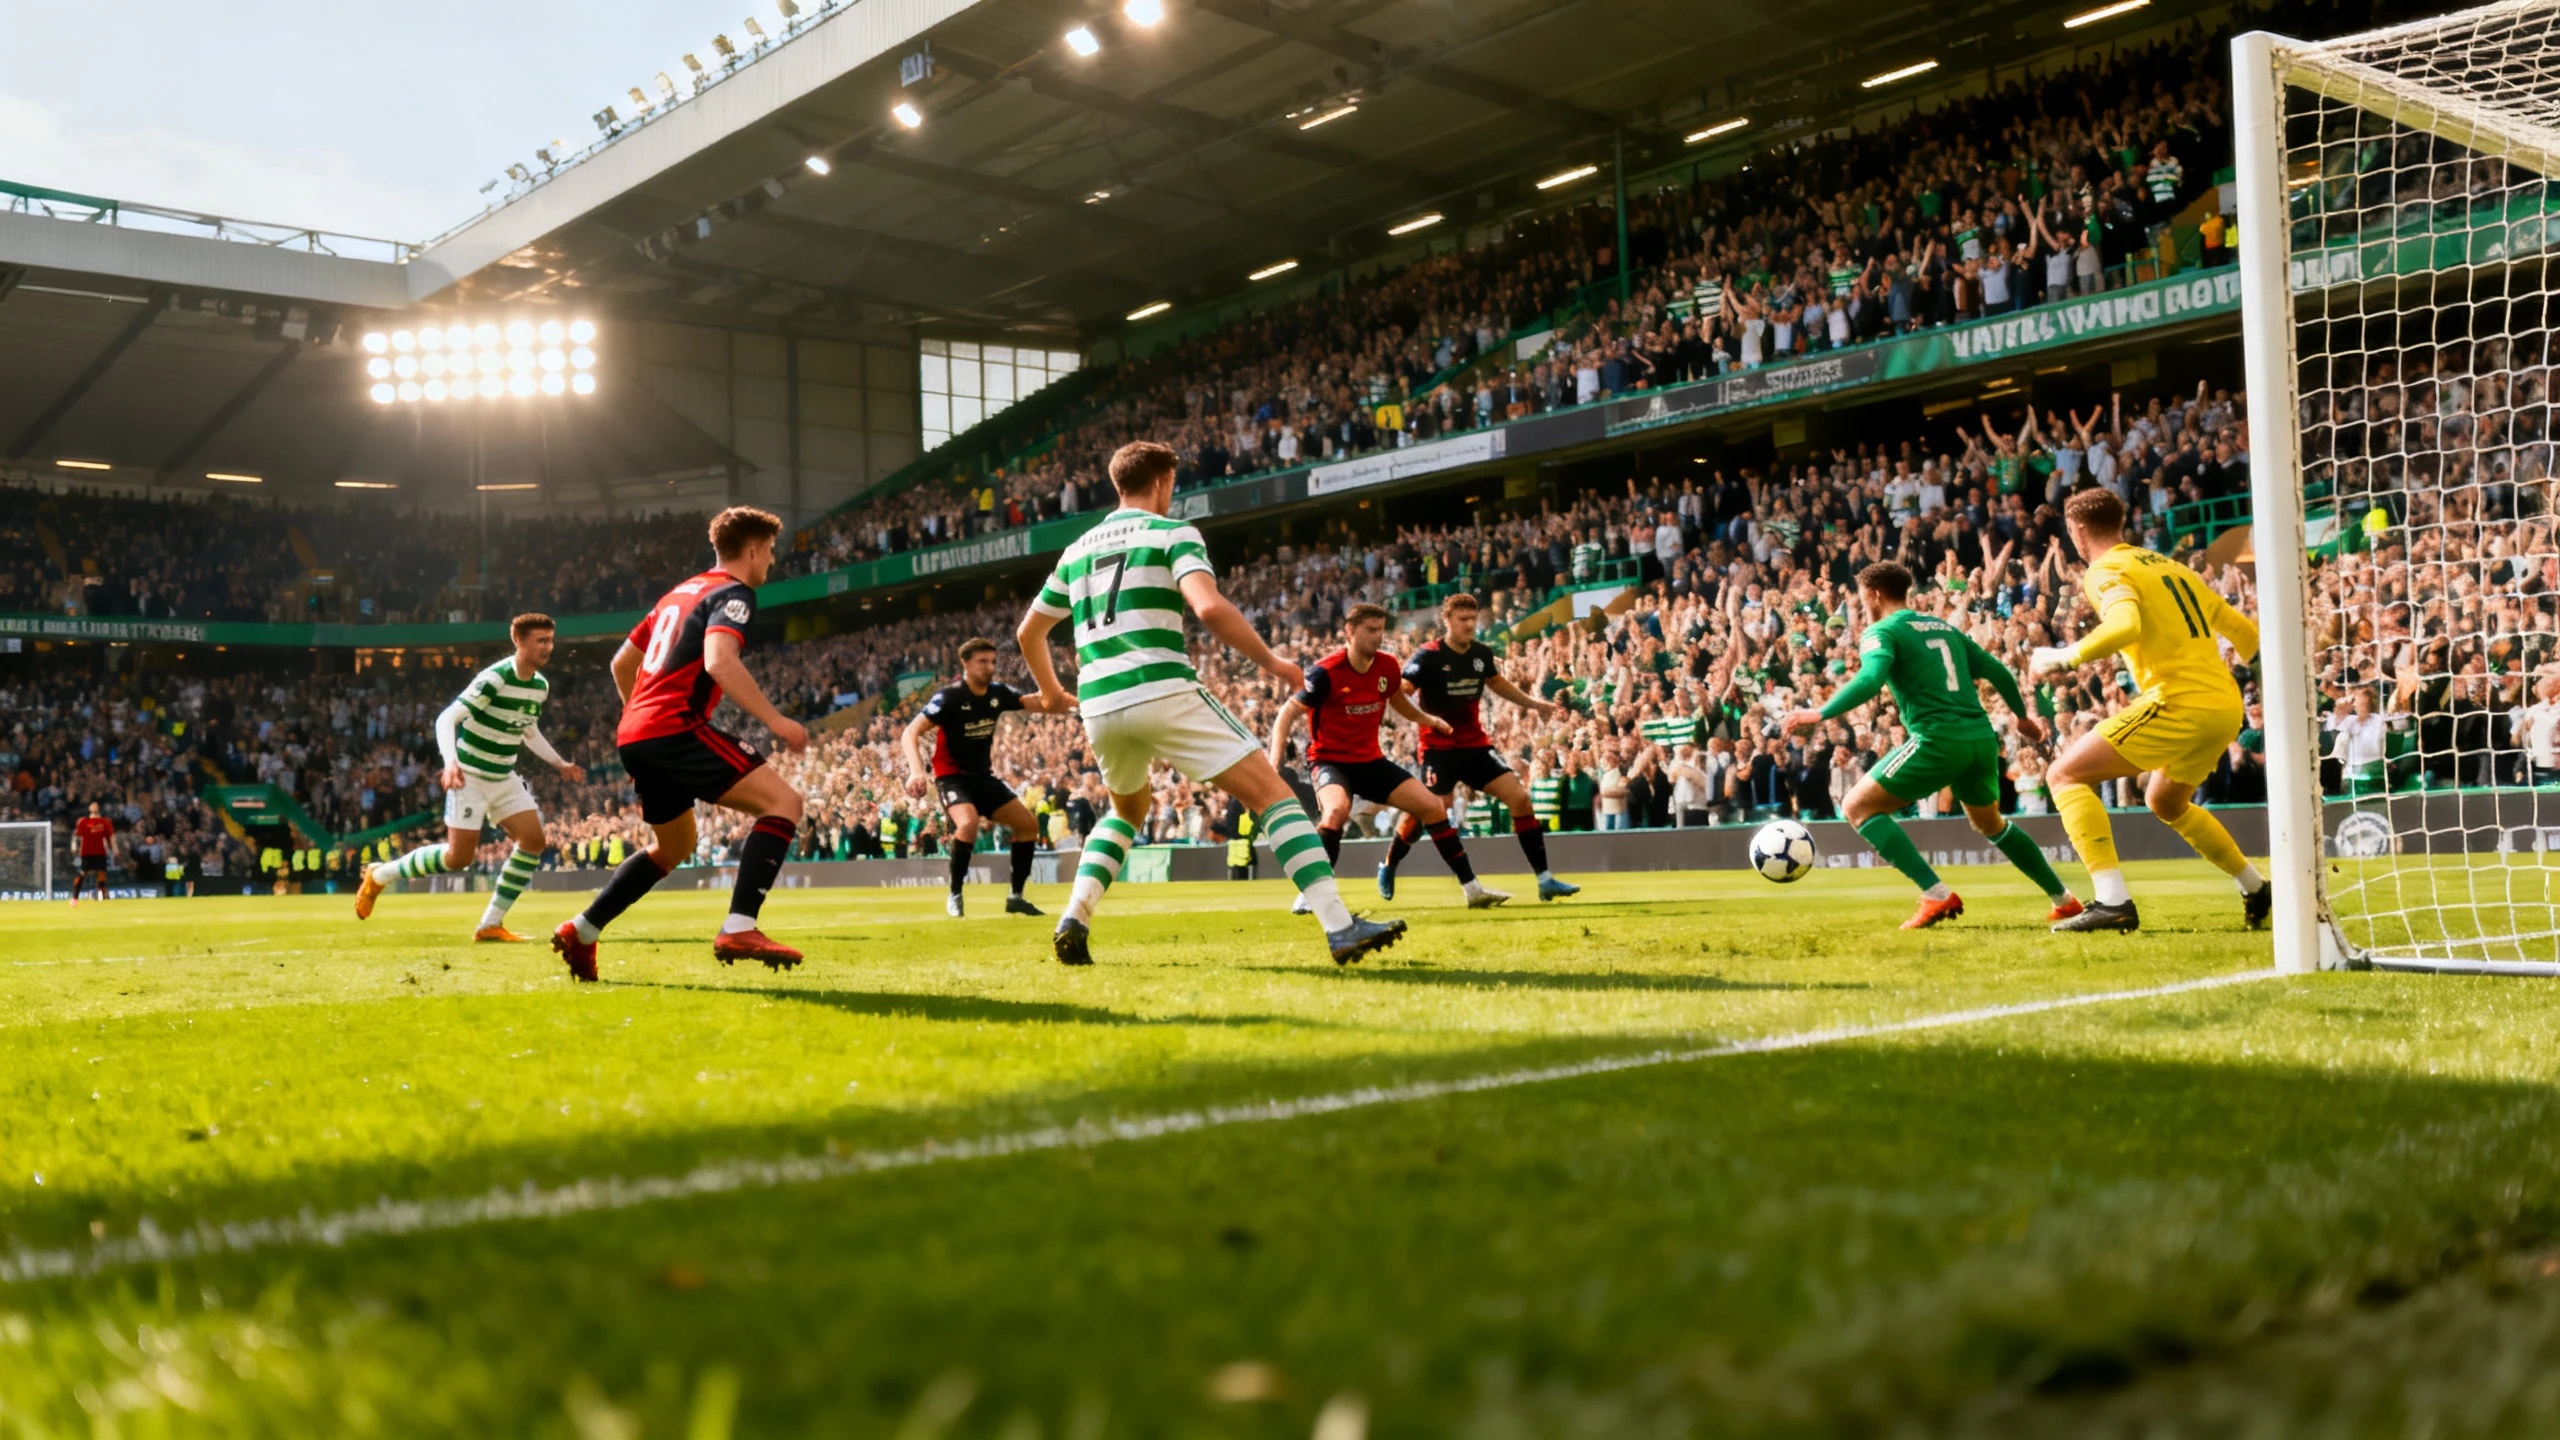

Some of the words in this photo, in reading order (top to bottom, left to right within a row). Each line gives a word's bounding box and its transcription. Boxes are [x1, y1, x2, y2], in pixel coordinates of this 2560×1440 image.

[642, 604, 680, 674] 8
[2161, 575, 2211, 639] 11
[1925, 638, 1959, 692] 7
